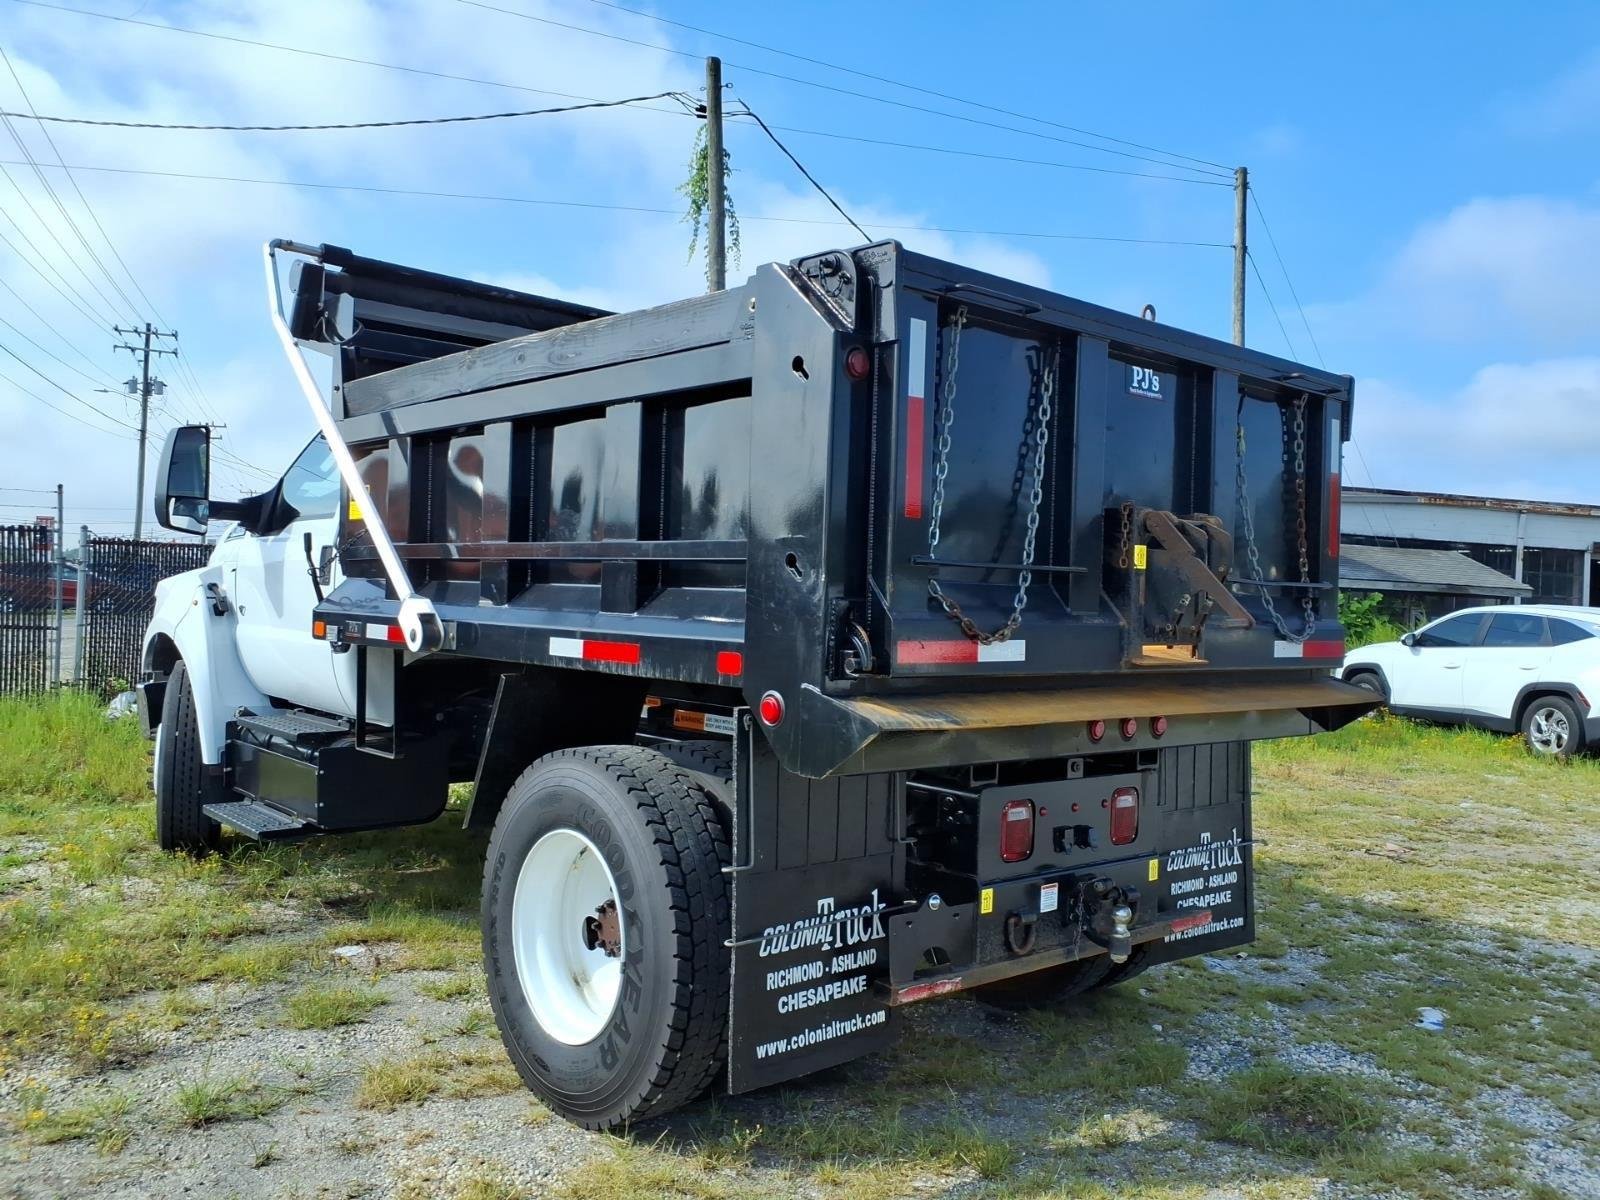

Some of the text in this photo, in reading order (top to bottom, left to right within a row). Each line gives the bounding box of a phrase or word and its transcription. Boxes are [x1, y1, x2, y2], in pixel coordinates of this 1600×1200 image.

[1132, 365, 1160, 392] PJ's
[1171, 872, 1237, 895] RICHMOND ASHLAND
[1177, 891, 1231, 909] CHESAPEAKE
[759, 914, 835, 958] COLONIAL
[1164, 917, 1244, 943] www.colonialtruck.com
[766, 948, 877, 991] RICHMOND ASHLAND
[777, 974, 867, 1014] CHESAPEAKE
[756, 1009, 886, 1060] www.colonialtruck.com
